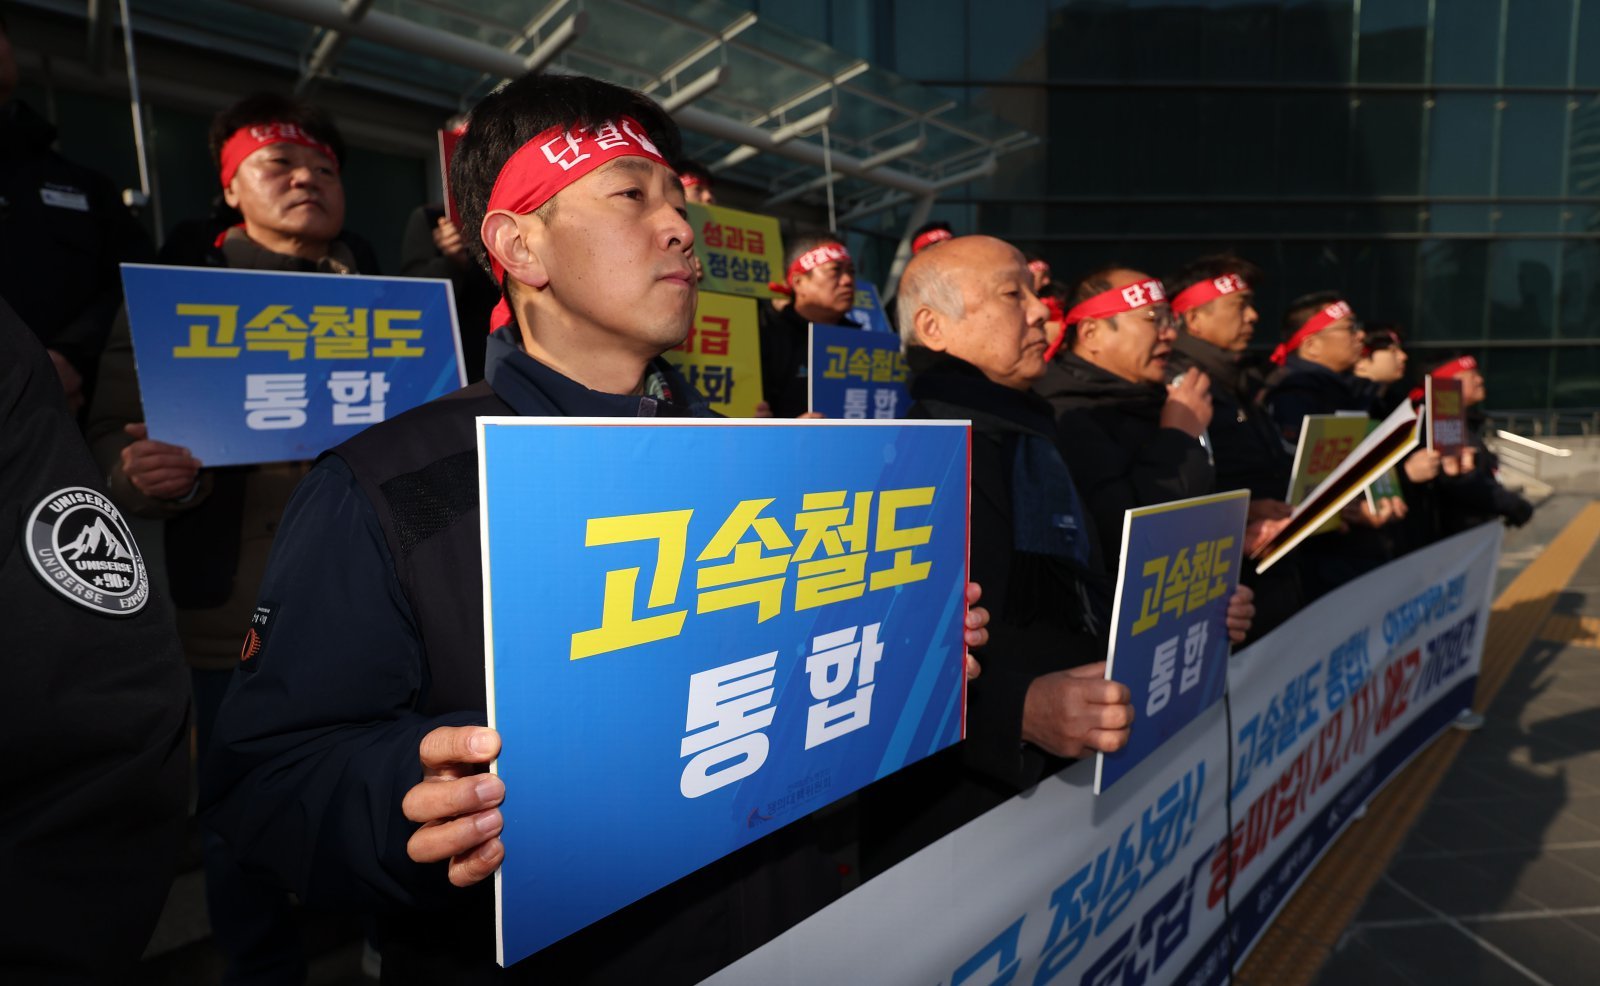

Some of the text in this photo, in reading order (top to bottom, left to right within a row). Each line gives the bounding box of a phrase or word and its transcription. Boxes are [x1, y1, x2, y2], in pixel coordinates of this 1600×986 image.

[703, 221, 765, 256] 성과급
[707, 252, 771, 283] 정상화
[173, 304, 425, 360] 고속철도
[48, 492, 119, 520] UNISERSE
[38, 548, 104, 604] UNISERSE
[75, 560, 133, 573] UNISERSE
[103, 573, 123, 588] 90
[570, 486, 936, 661] 고속철도
[1131, 536, 1234, 637] 고속철도
[1230, 658, 1324, 802] 고속철도
